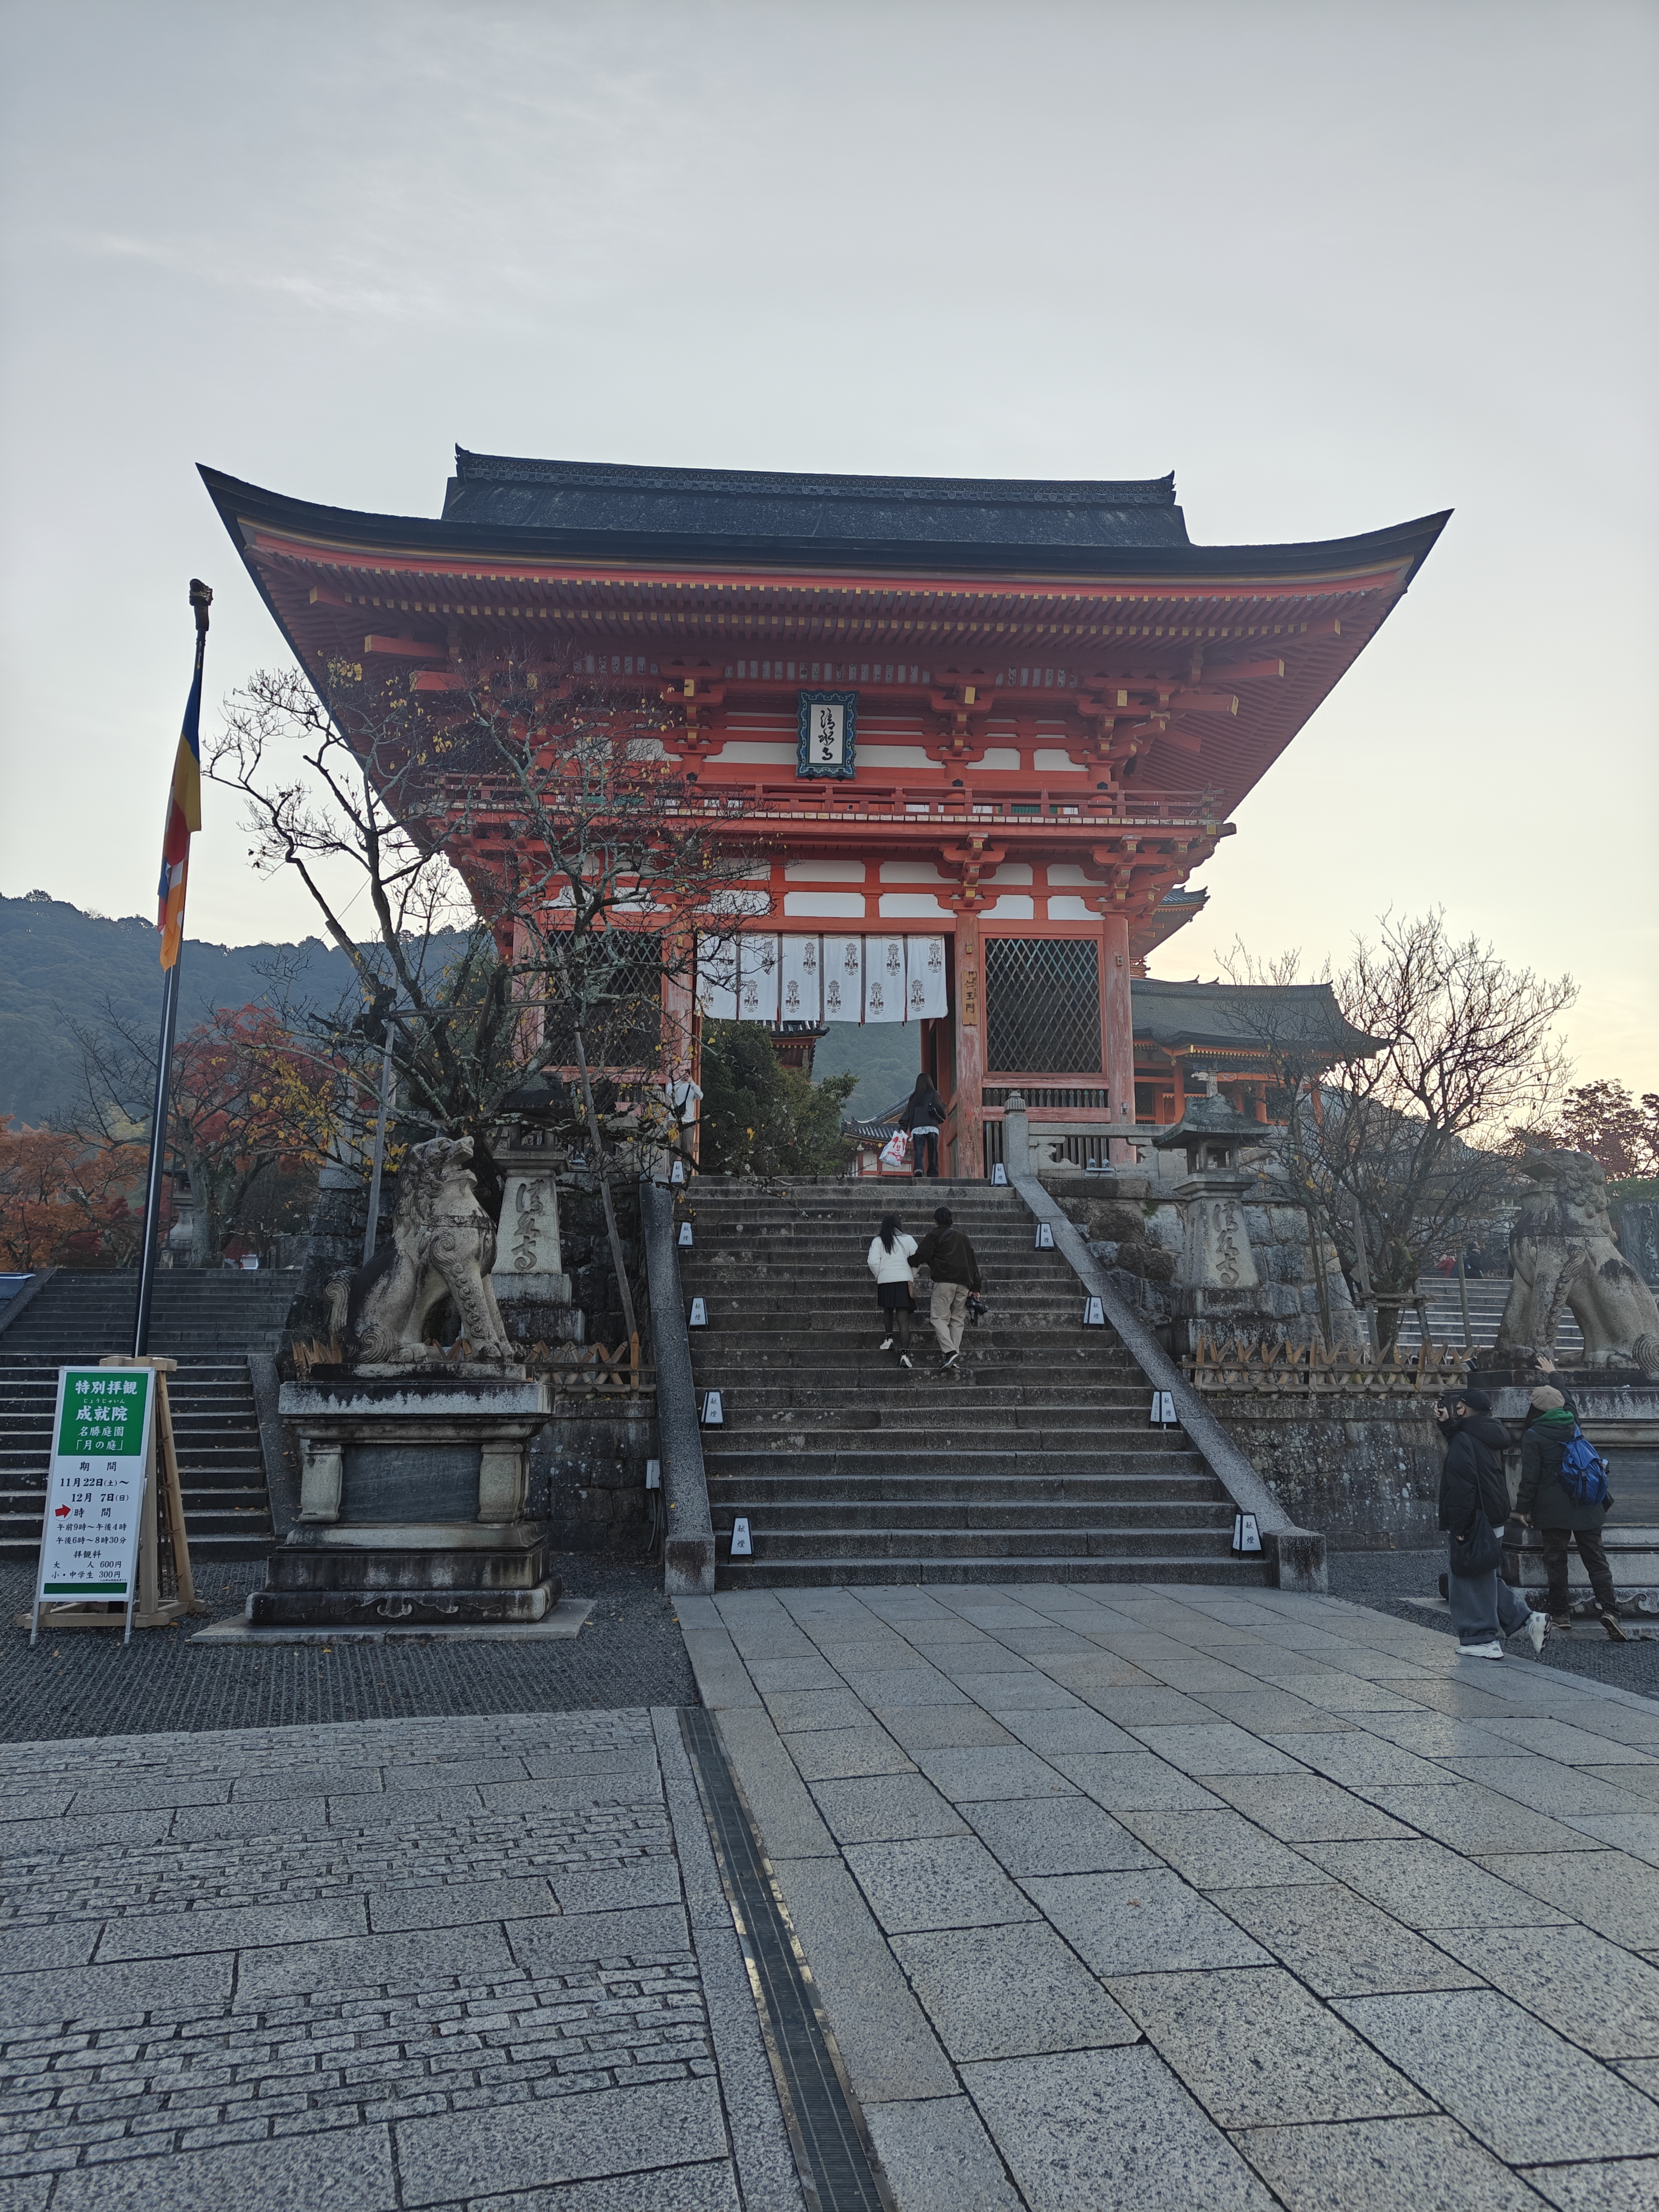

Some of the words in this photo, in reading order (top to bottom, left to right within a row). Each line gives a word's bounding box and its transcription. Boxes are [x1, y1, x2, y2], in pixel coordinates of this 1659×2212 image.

[965, 980, 975, 1014] 仁王門
[75, 1380, 137, 1395] 特別拝観
[75, 1405, 129, 1421] 成就院
[77, 1426, 124, 1437] 名勝庭園
[76, 1440, 123, 1451] 「月の庭」
[57, 1523, 127, 1531] 午前9時～午後4時
[56, 1536, 126, 1545] 午後6時～8時30分
[73, 1550, 102, 1559] 拝観料
